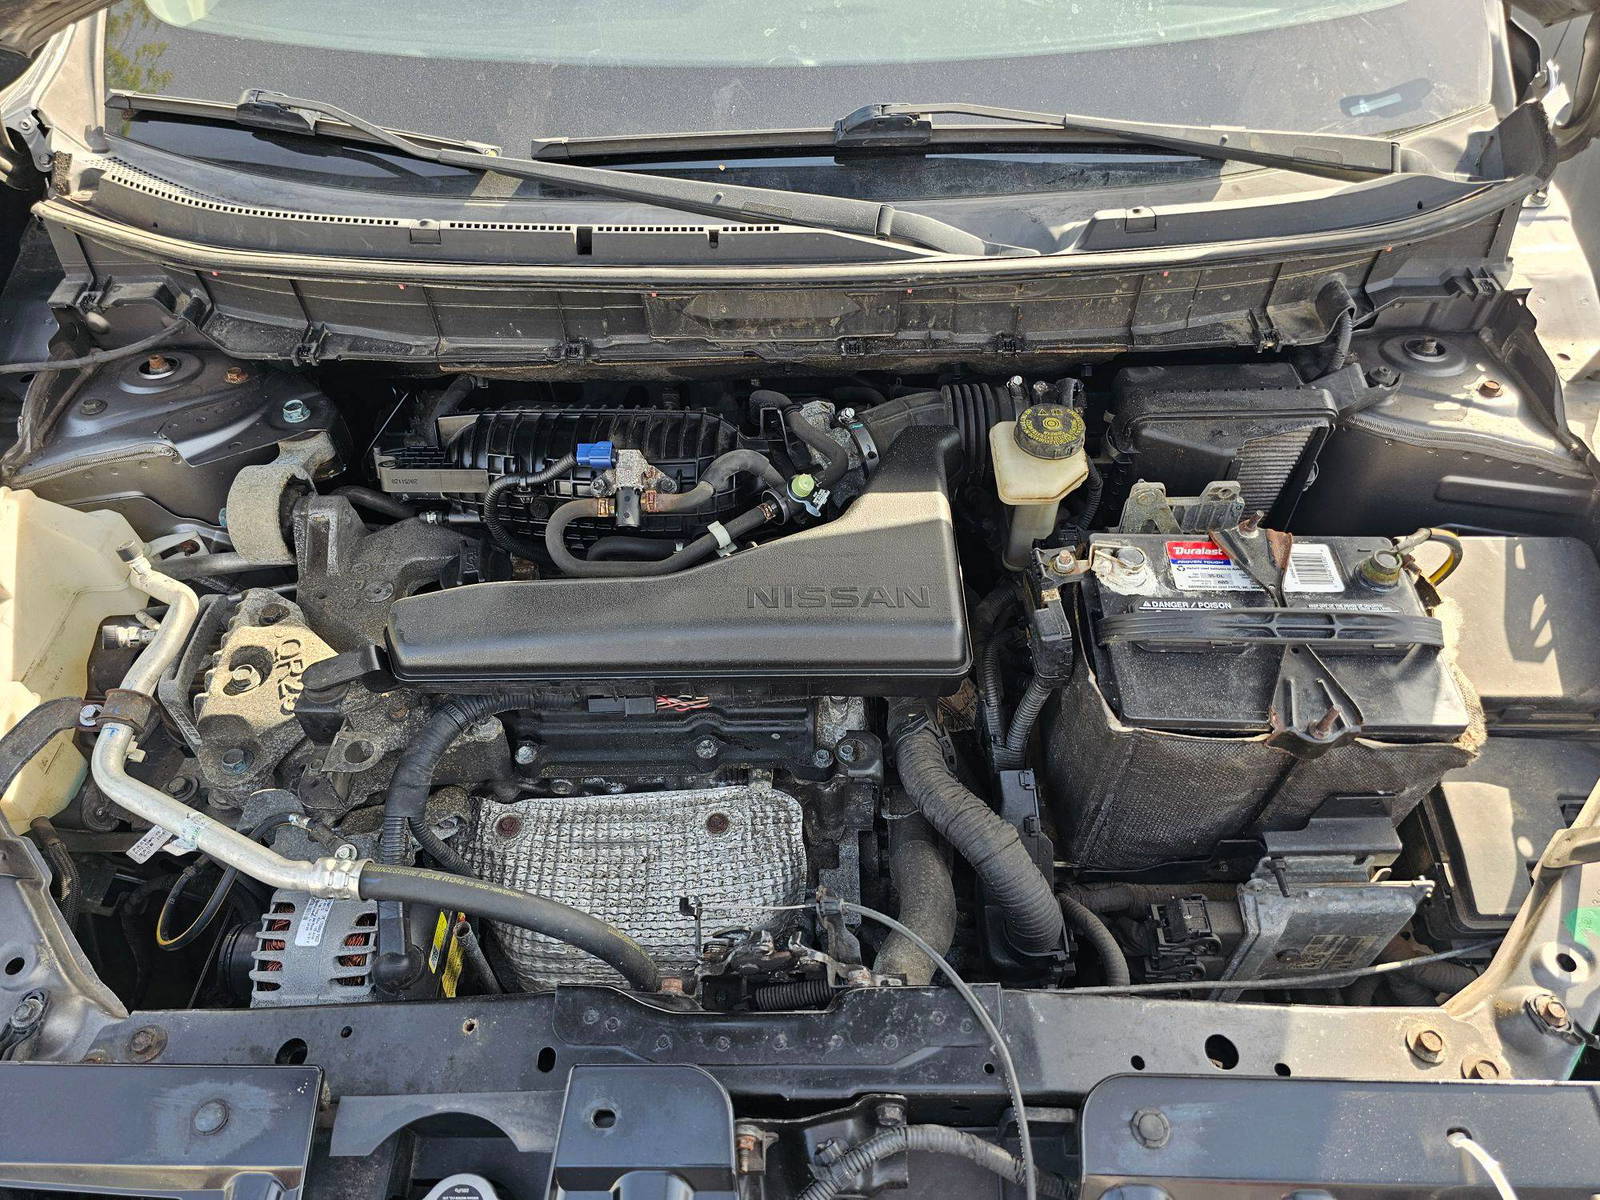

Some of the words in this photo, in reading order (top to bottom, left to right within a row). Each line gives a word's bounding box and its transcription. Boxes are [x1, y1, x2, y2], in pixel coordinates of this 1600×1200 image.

[1173, 546, 1223, 555] Duralast
[747, 585, 931, 609] NISSAN
[1198, 601, 1232, 609] POISON
